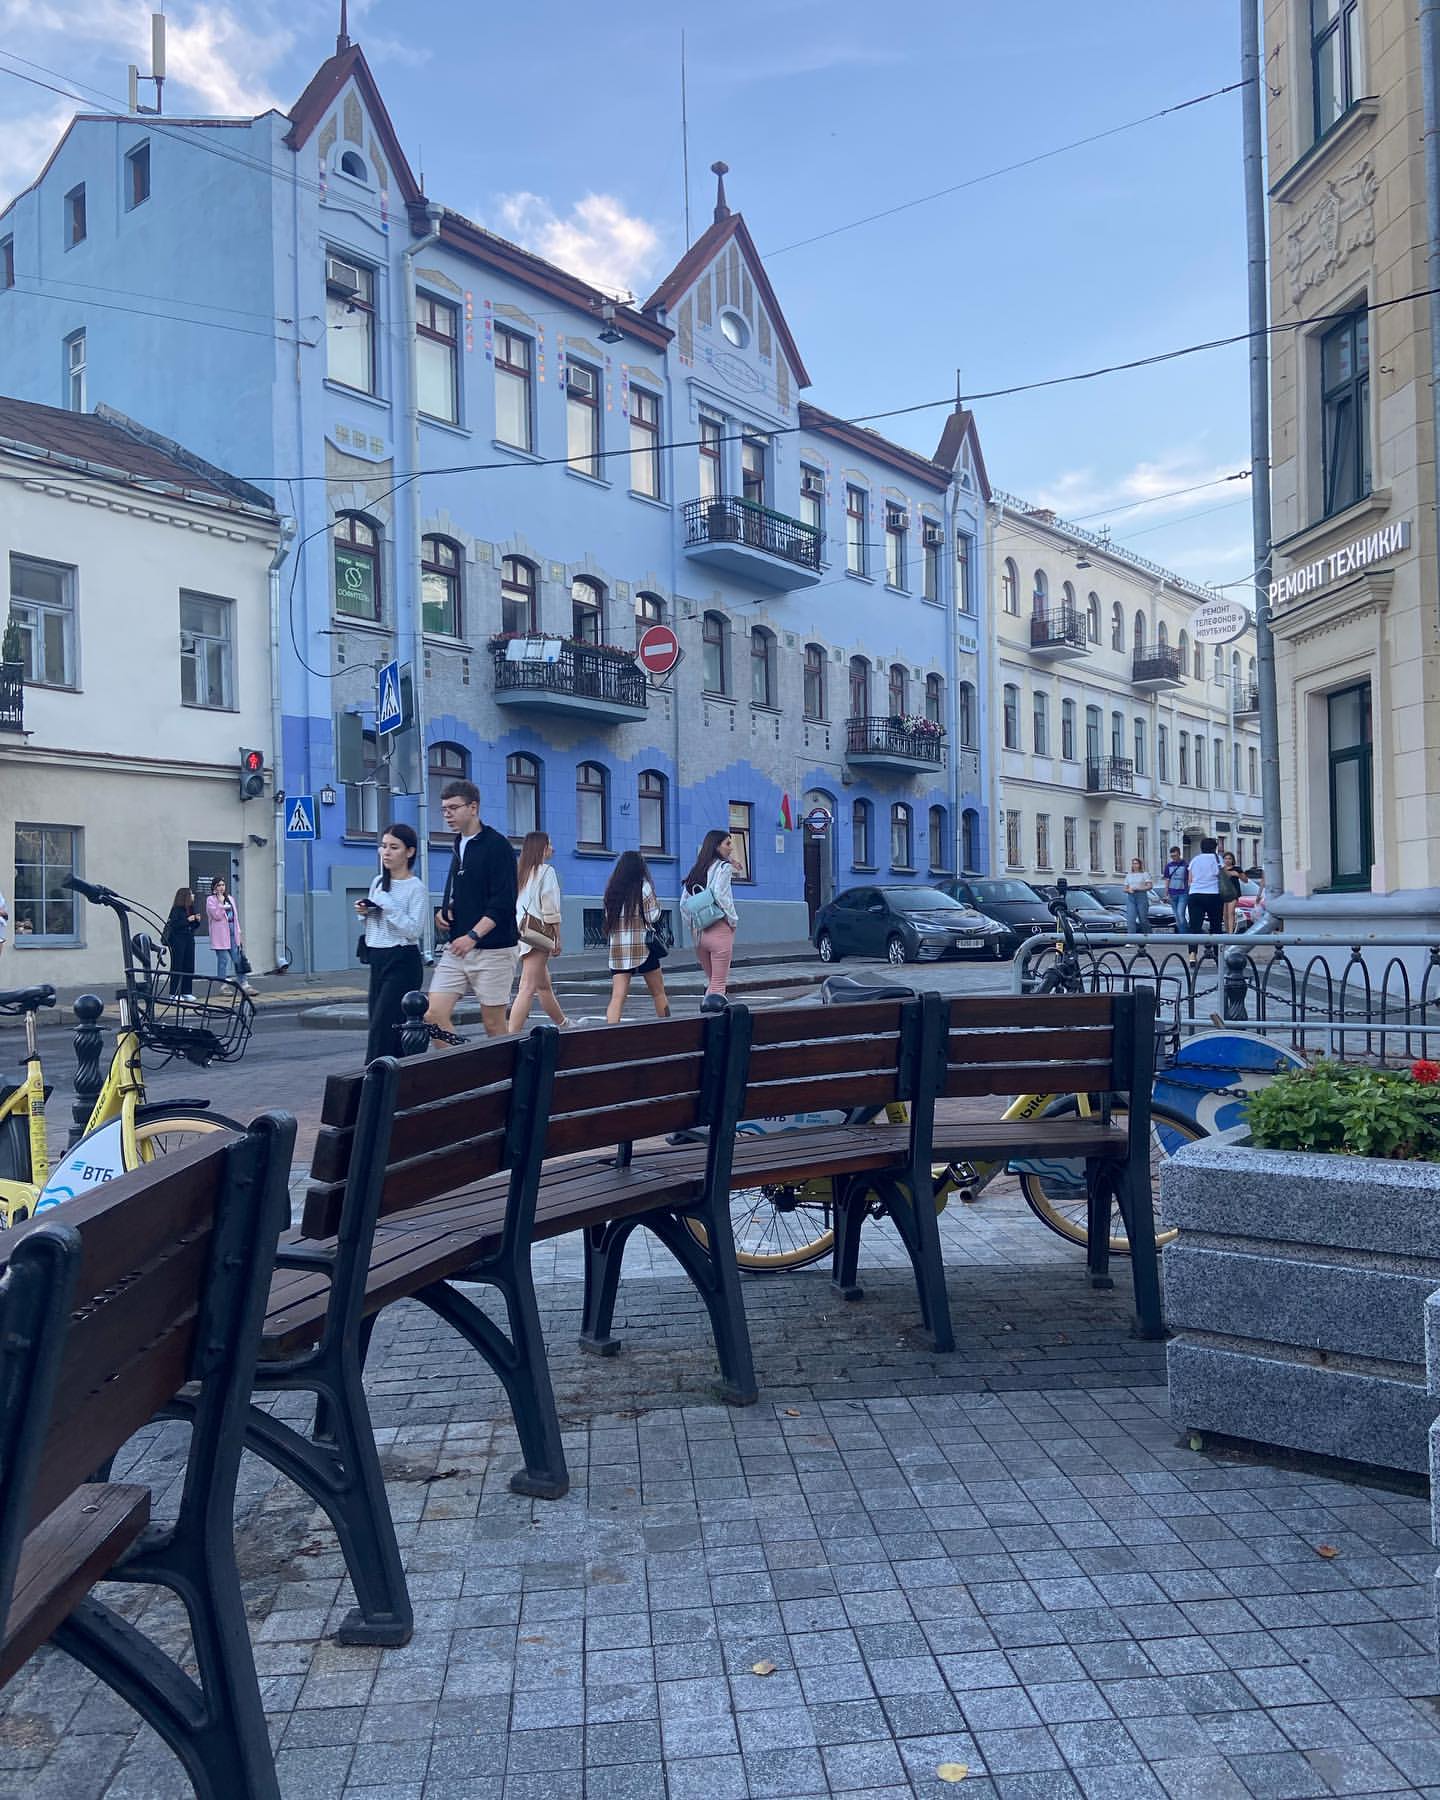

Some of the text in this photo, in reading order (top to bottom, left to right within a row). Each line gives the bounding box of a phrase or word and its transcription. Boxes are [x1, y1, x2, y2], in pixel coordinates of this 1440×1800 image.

[1269, 522, 1403, 607] РЕМОНТ ТЕХНИКИ
[1202, 605, 1230, 616] РЕМОНТ
[1195, 614, 1237, 627] ТЕЛЕФОНОВ
[1196, 625, 1237, 637] НОУТБУКОВ
[83, 1165, 113, 1182] ВТБ
